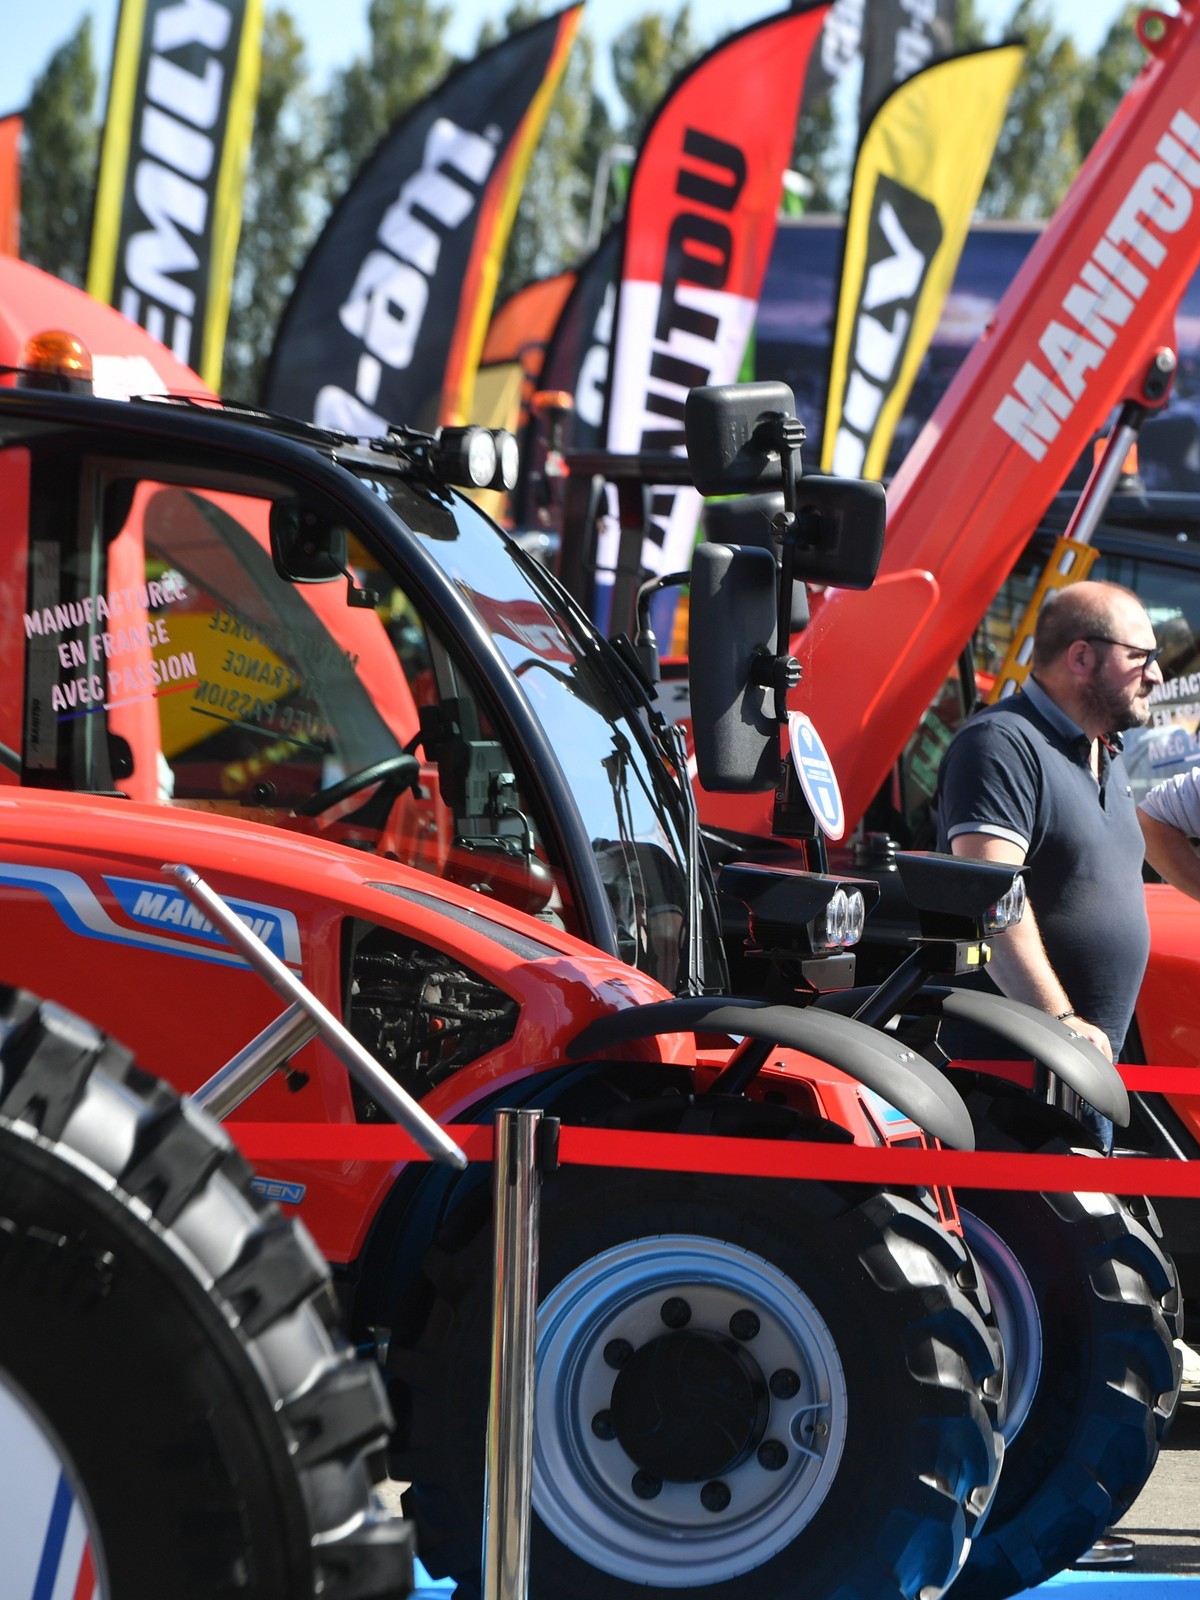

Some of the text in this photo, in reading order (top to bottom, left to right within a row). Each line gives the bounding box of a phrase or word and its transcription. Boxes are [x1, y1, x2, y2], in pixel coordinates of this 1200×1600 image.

[22, 571, 188, 640] MANUFACTURÉE
[57, 618, 171, 669] EN FRANCE
[51, 651, 198, 712] AVEC PASSION
